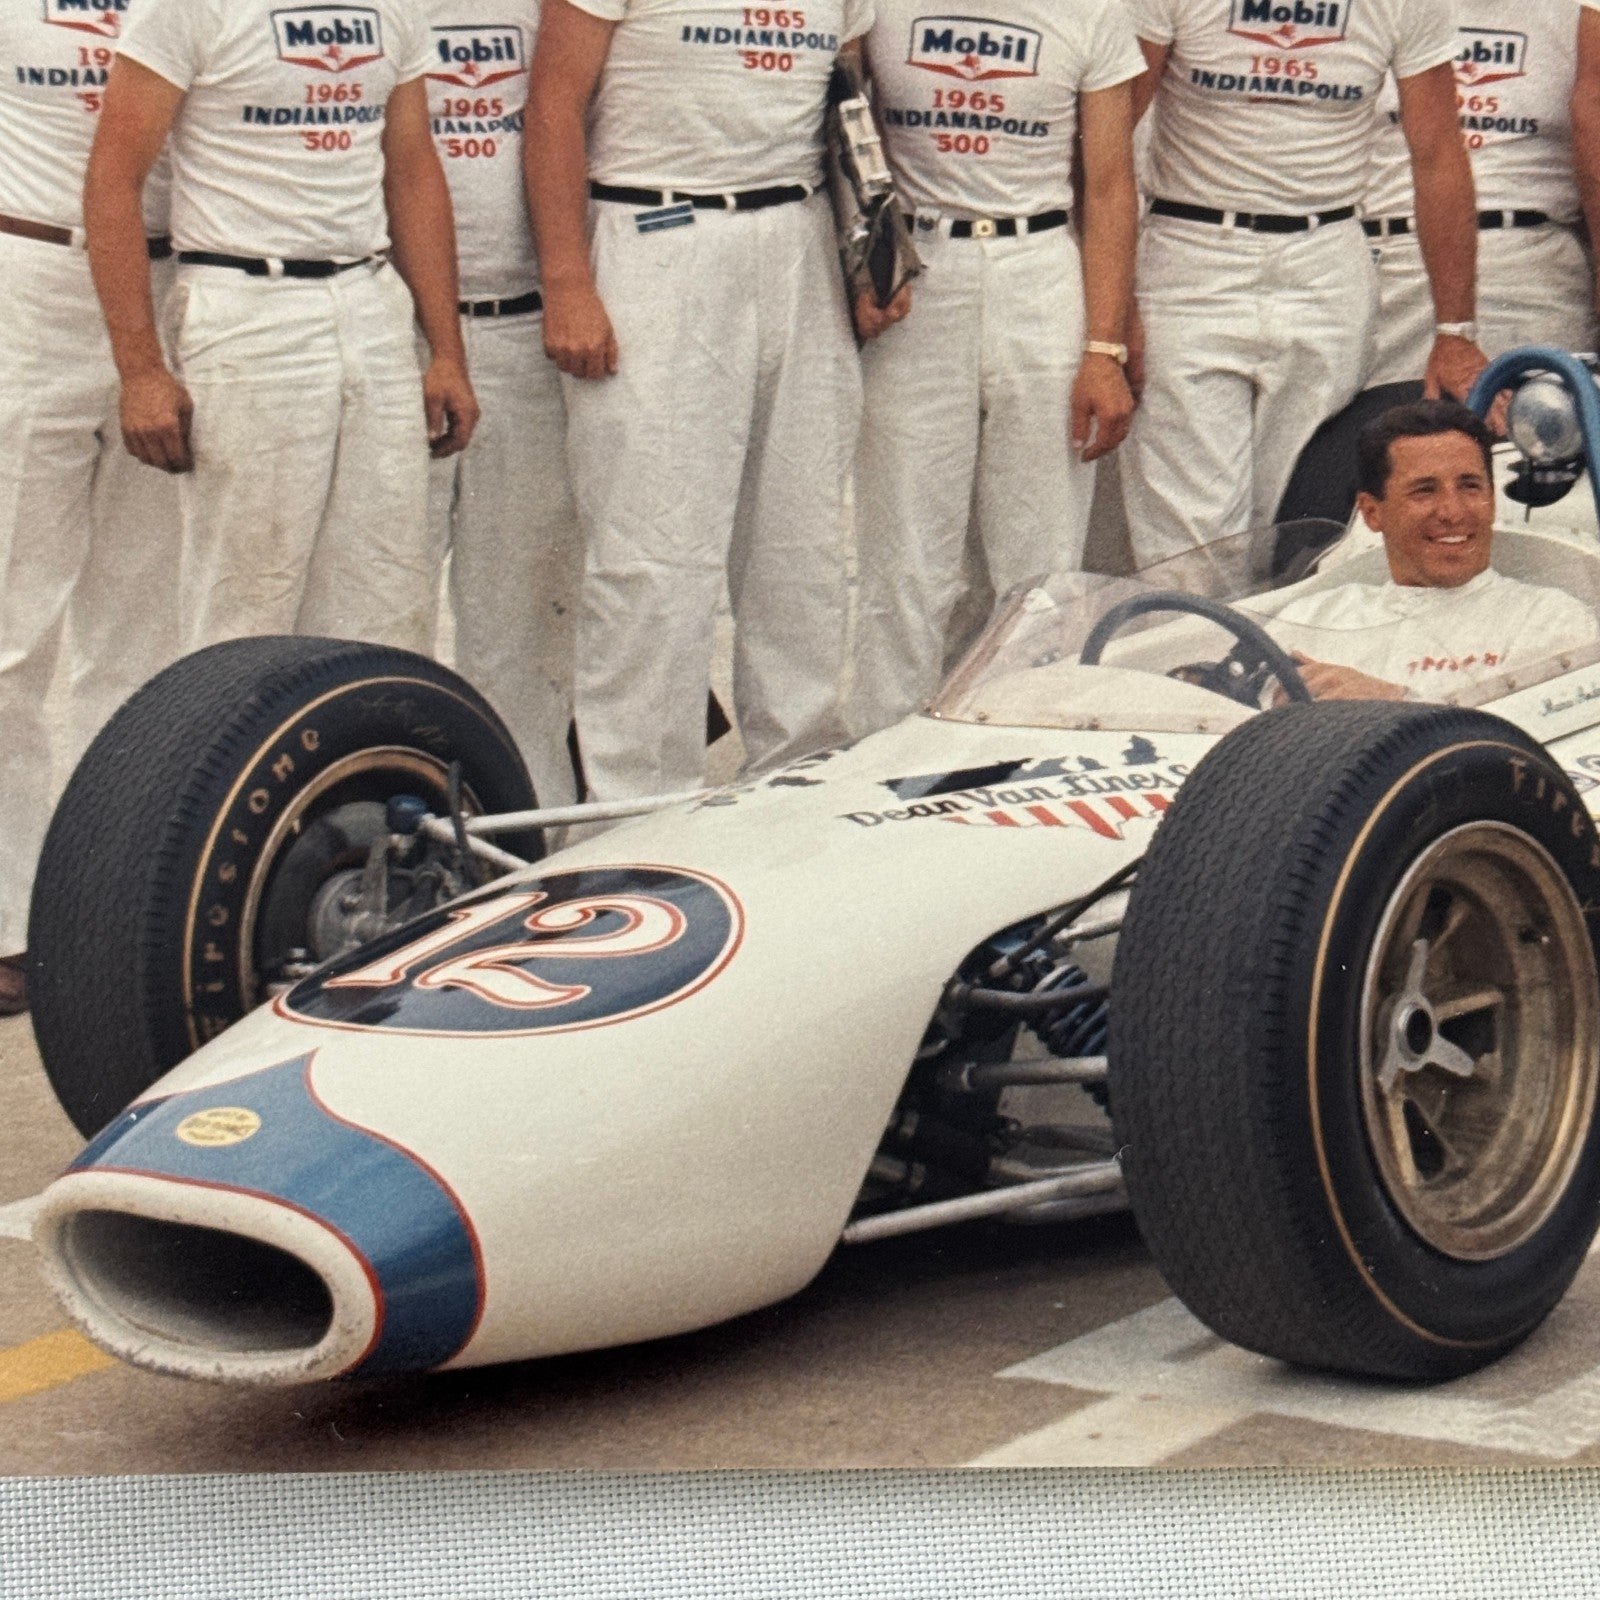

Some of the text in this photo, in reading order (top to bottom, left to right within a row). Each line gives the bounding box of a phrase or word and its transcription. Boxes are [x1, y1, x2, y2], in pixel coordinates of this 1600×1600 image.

[743, 8, 807, 30] 1965
[1241, 0, 1341, 27] Mobil
[284, 18, 375, 46] Mobil
[921, 28, 1028, 62] Mobil
[1250, 55, 1319, 80] 1965
[304, 82, 363, 104] 1965
[1190, 68, 1364, 101] INDIANAPOLIS
[442, 98, 504, 117] 1965
[931, 88, 1006, 113] 1965
[447, 138, 497, 158] 500
[838, 772, 1181, 828] Dean Van Lines
[321, 891, 688, 1010] 12
